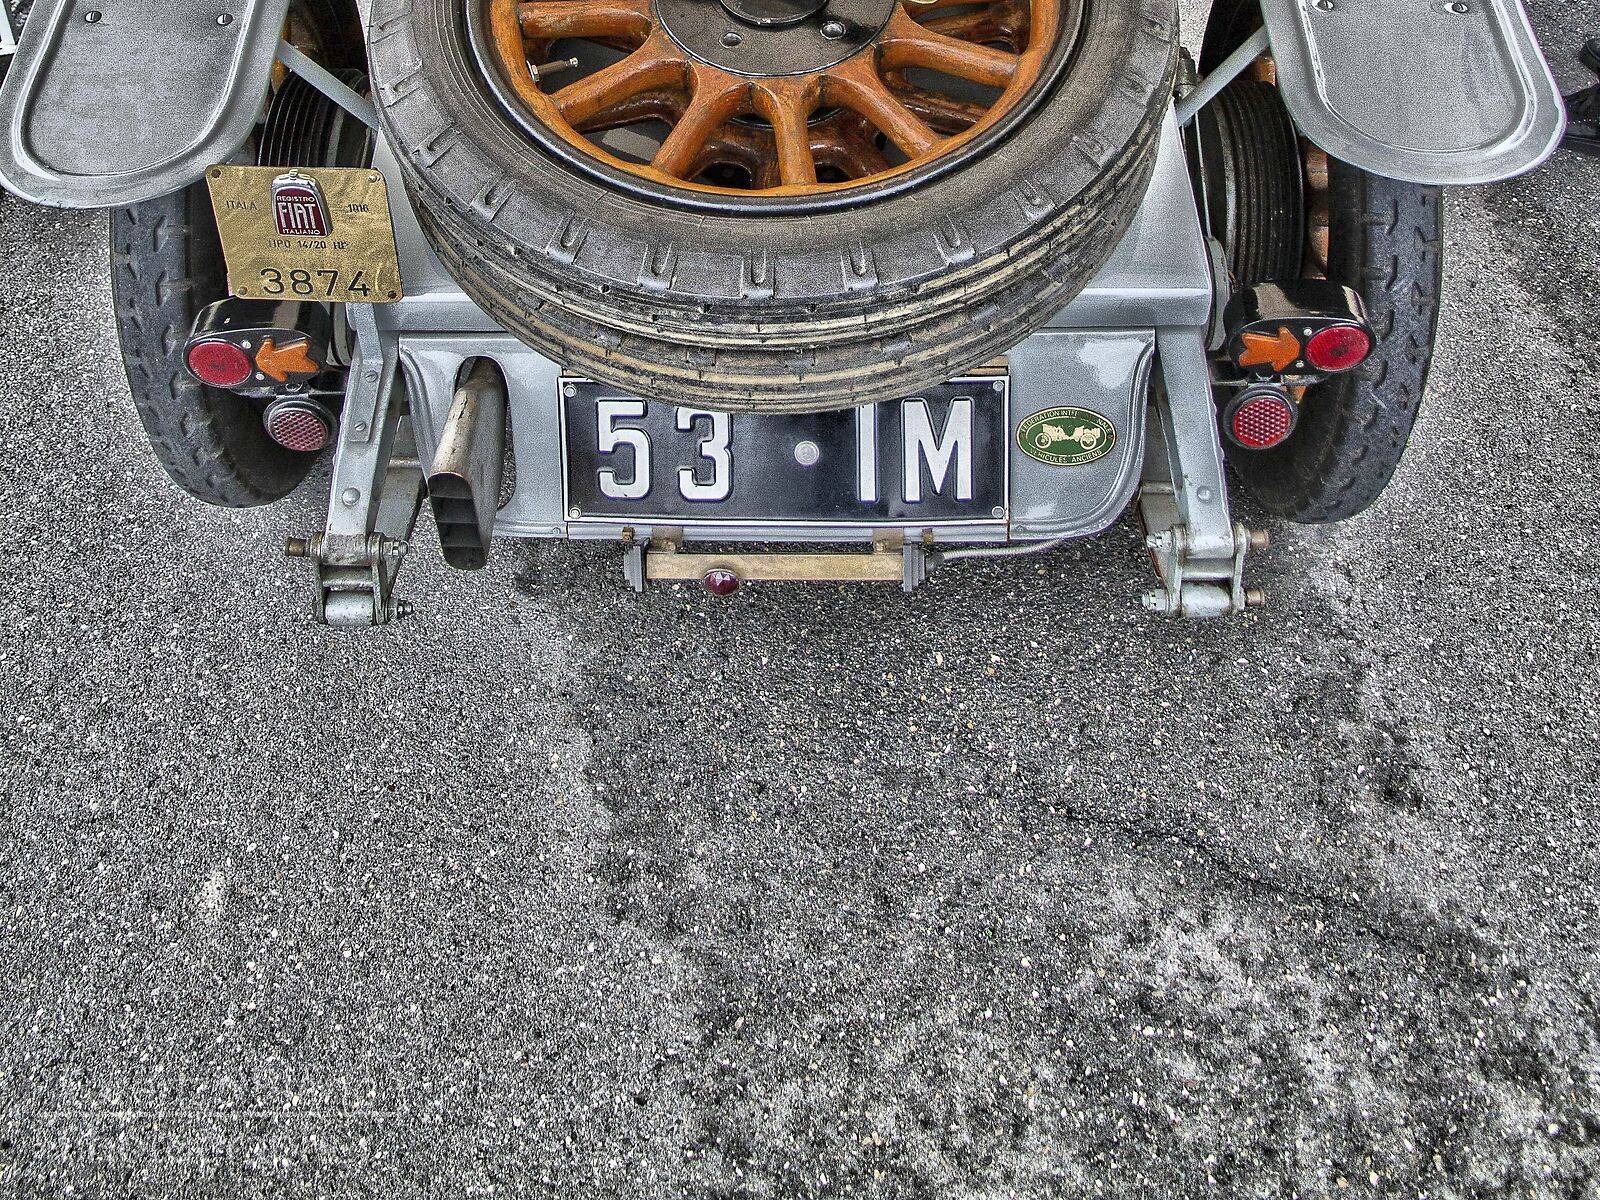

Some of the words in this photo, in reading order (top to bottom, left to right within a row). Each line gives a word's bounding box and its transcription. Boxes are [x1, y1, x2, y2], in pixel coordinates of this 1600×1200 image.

[276, 195, 315, 203] REGISTRO
[278, 202, 316, 229] FIAT
[282, 228, 320, 236] ITALIANO
[297, 240, 327, 250] 14/20
[260, 267, 371, 297] 3874
[596, 399, 734, 502] 53
[1071, 448, 1103, 464] ANCIENS
